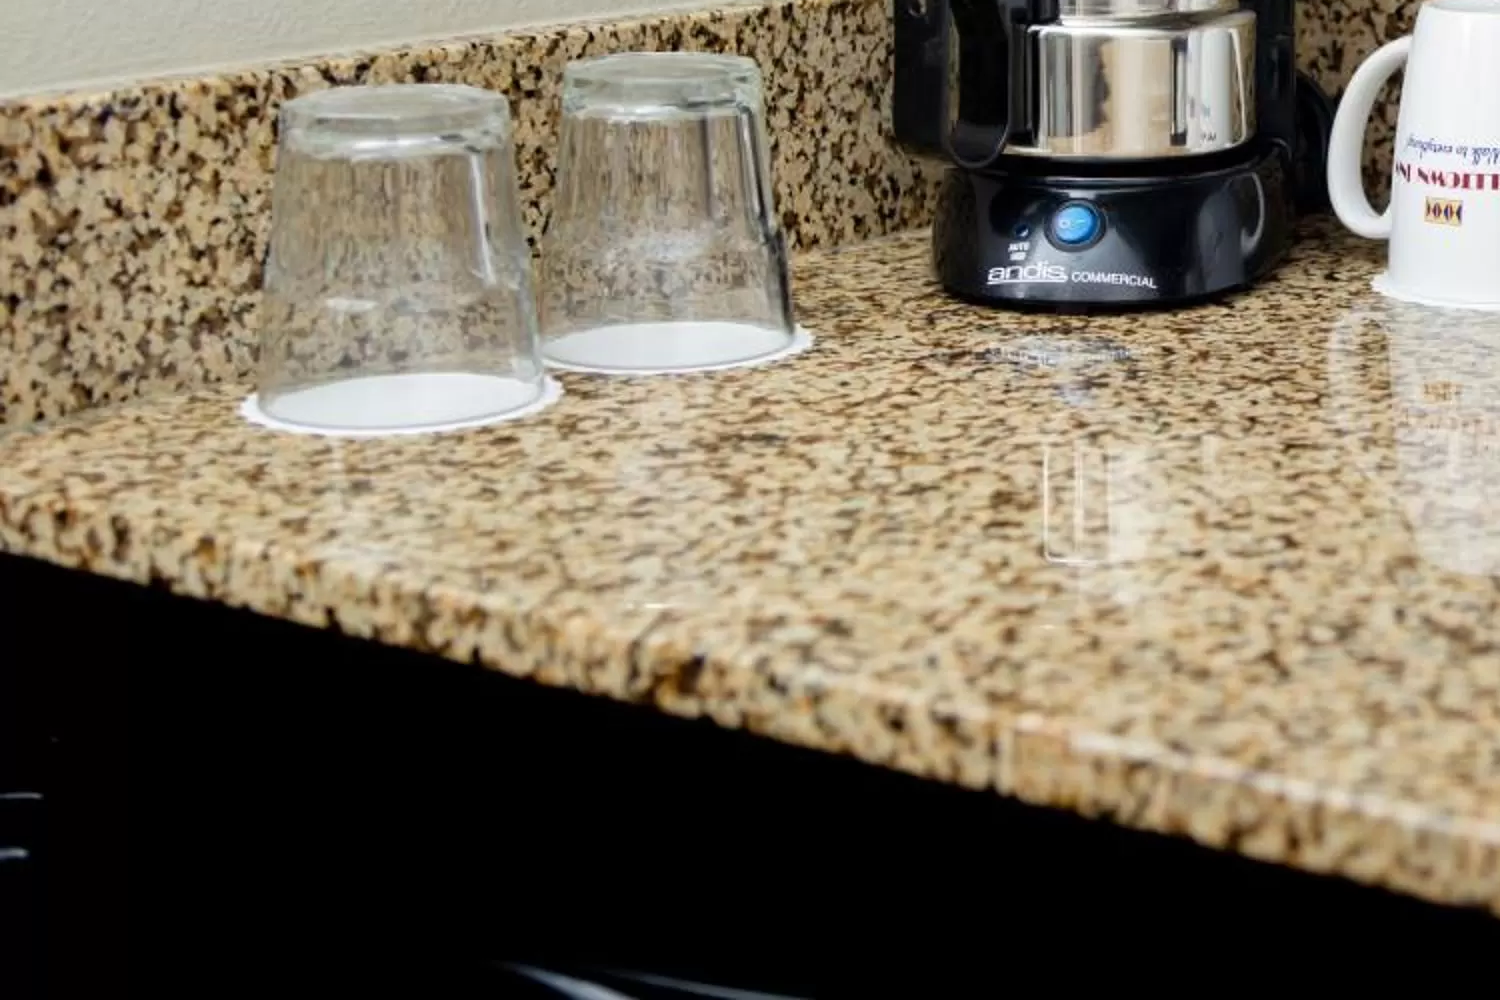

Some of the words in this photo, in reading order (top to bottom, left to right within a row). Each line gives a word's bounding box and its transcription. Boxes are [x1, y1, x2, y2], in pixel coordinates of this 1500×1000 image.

[1456, 146, 1469, 159] to
[986, 260, 1069, 285] andis
[1071, 271, 1158, 289] COMMERCIAL
